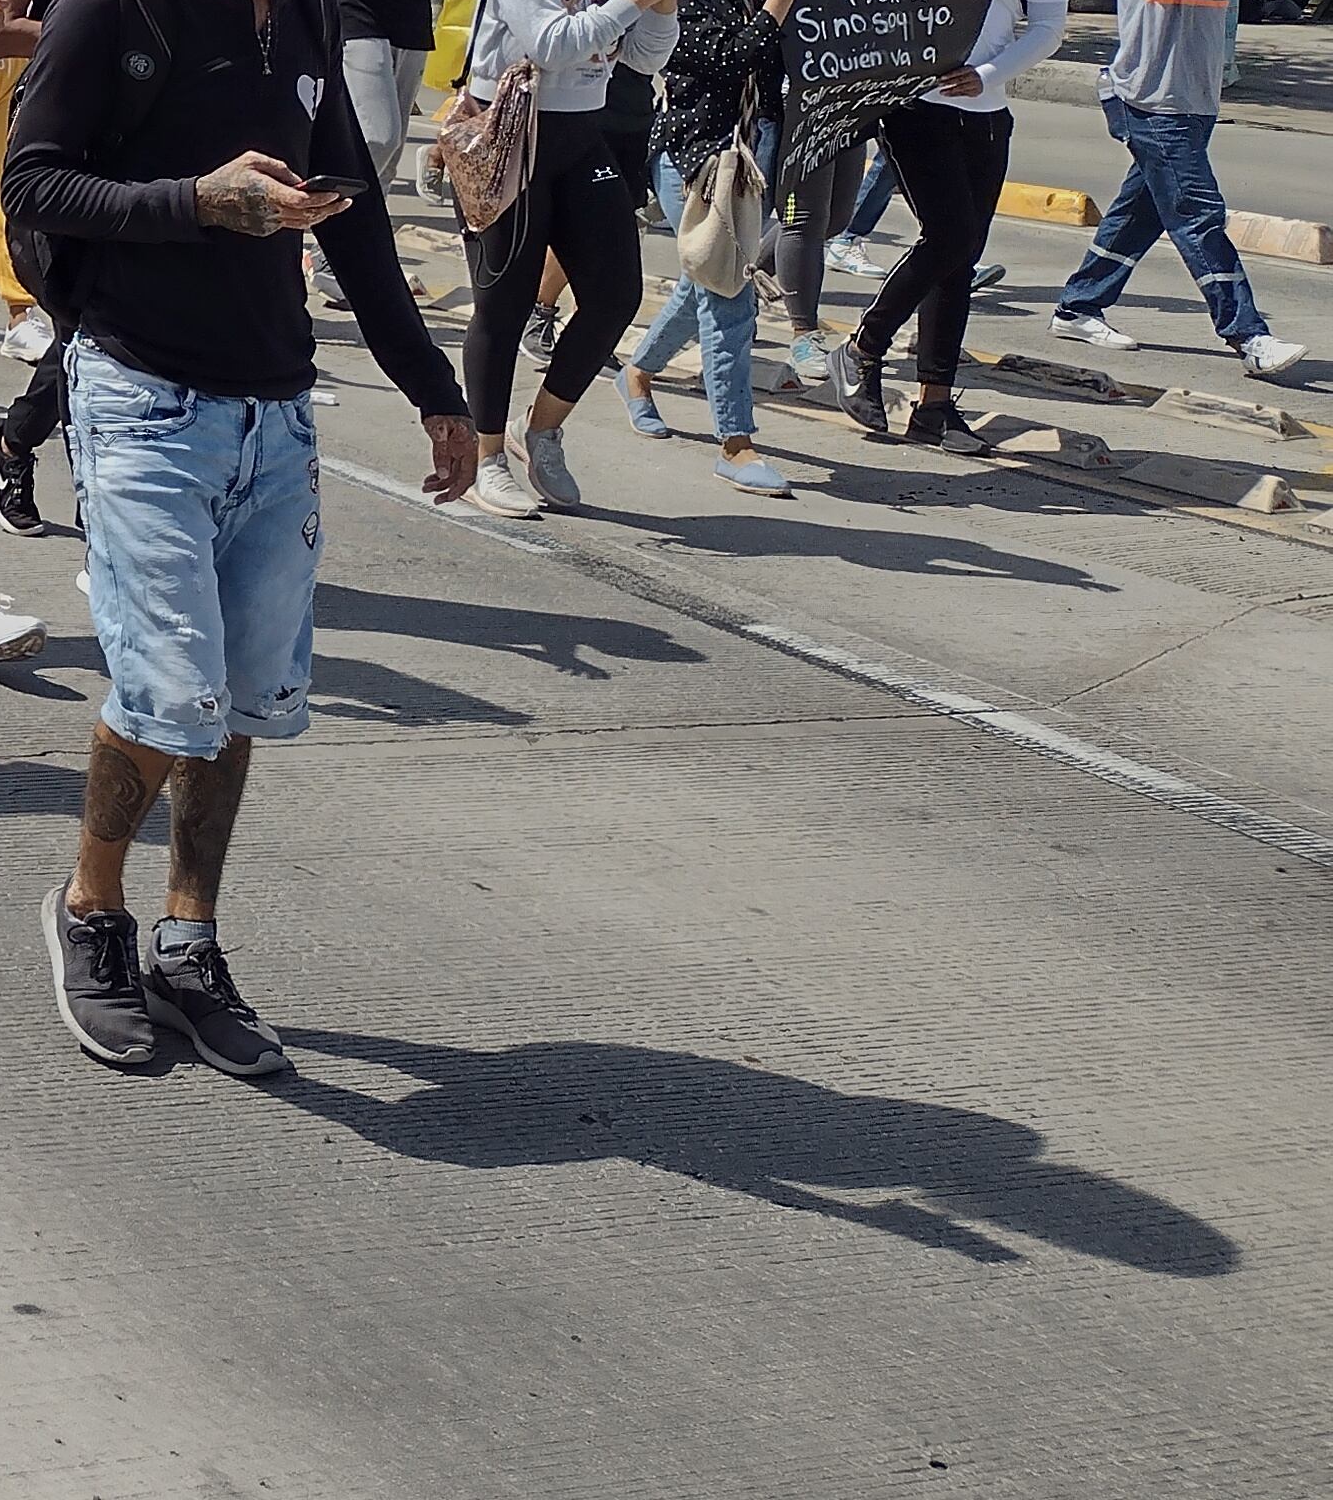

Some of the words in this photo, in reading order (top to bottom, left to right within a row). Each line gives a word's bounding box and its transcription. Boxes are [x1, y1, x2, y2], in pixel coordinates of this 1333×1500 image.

[795, 7, 828, 43] Si
[833, 13, 867, 38] no
[871, 10, 909, 41] soy
[923, 46, 937, 64] a
